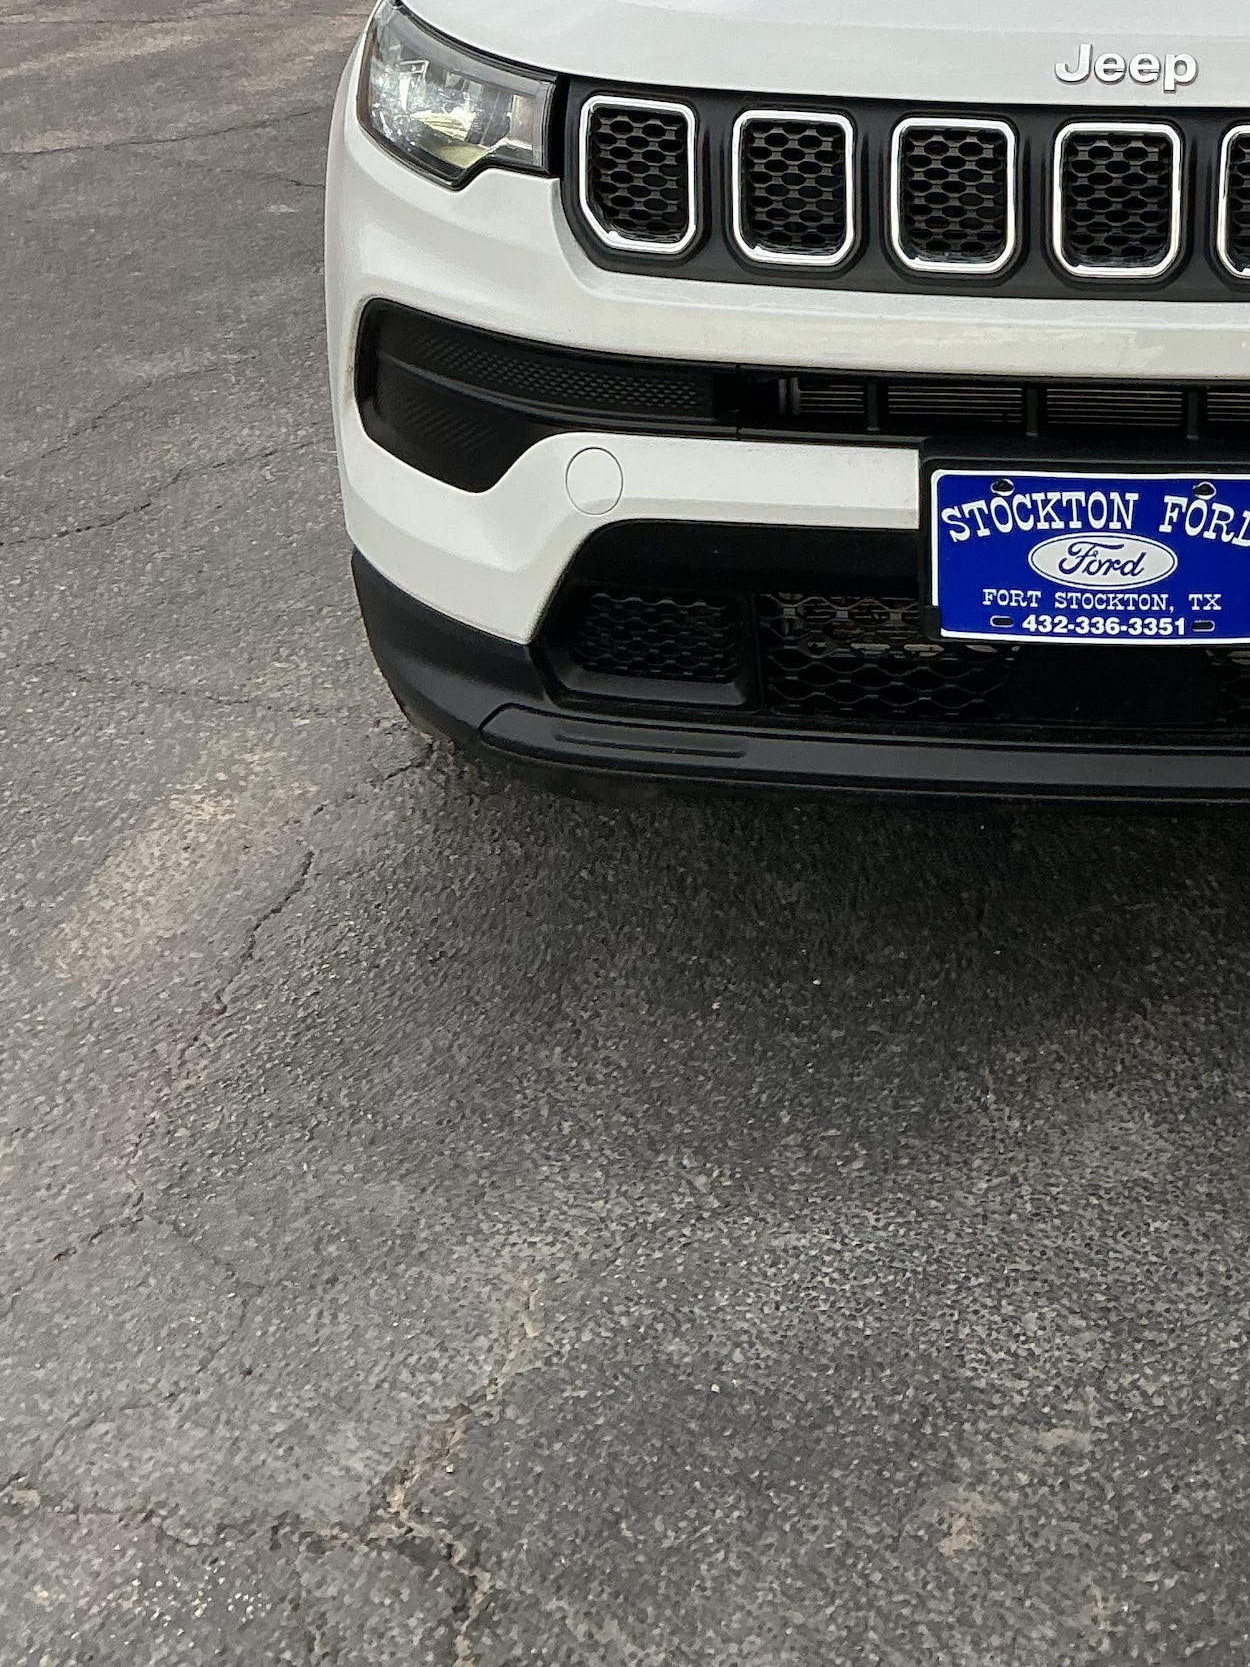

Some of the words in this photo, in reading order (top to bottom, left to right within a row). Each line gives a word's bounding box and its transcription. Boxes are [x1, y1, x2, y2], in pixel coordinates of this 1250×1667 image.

[1054, 42, 1199, 94] Jeep
[940, 490, 1140, 543] STOCKTON
[1058, 540, 1147, 578] Ford
[982, 588, 1041, 608] FORT
[1054, 592, 1175, 613] STOCKTON,
[1188, 593, 1222, 612] TX
[1022, 613, 1185, 636] 432-336-3351
